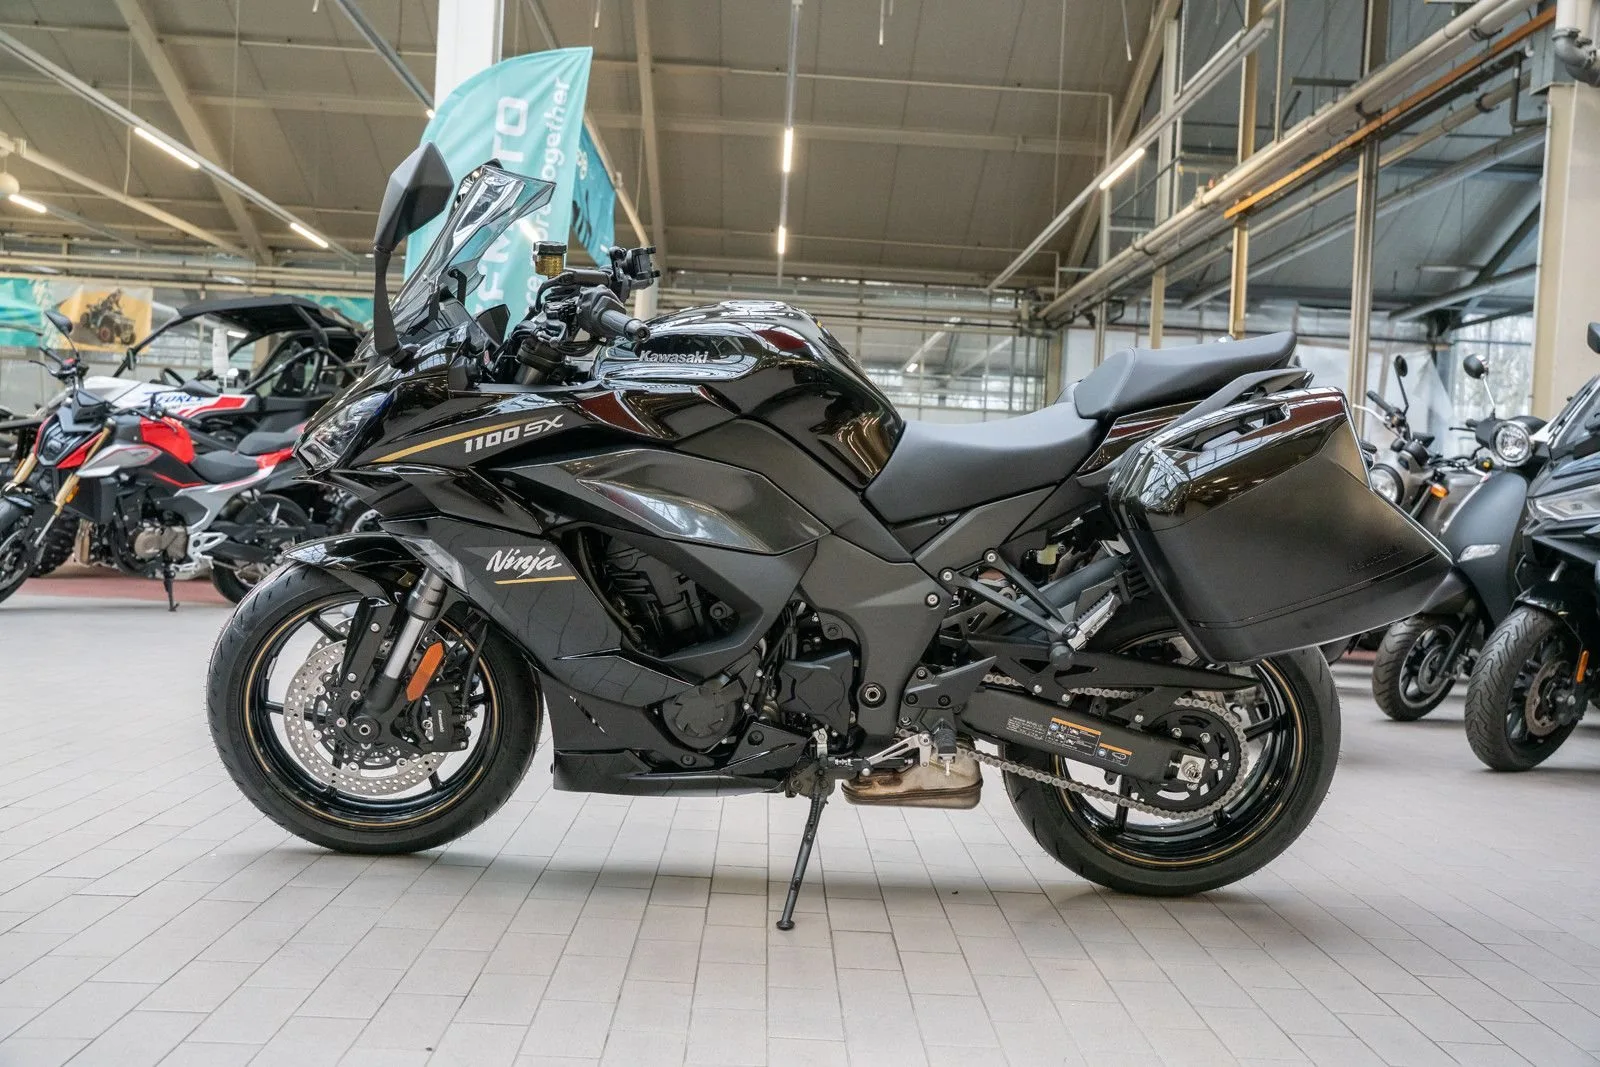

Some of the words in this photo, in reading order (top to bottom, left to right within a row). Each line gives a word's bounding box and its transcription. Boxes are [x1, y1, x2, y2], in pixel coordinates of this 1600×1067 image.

[541, 76, 570, 182] ogether
[639, 350, 709, 364] Kawasaki
[464, 426, 520, 453] 1100
[523, 414, 564, 437] SX
[485, 547, 562, 579] Ninja
